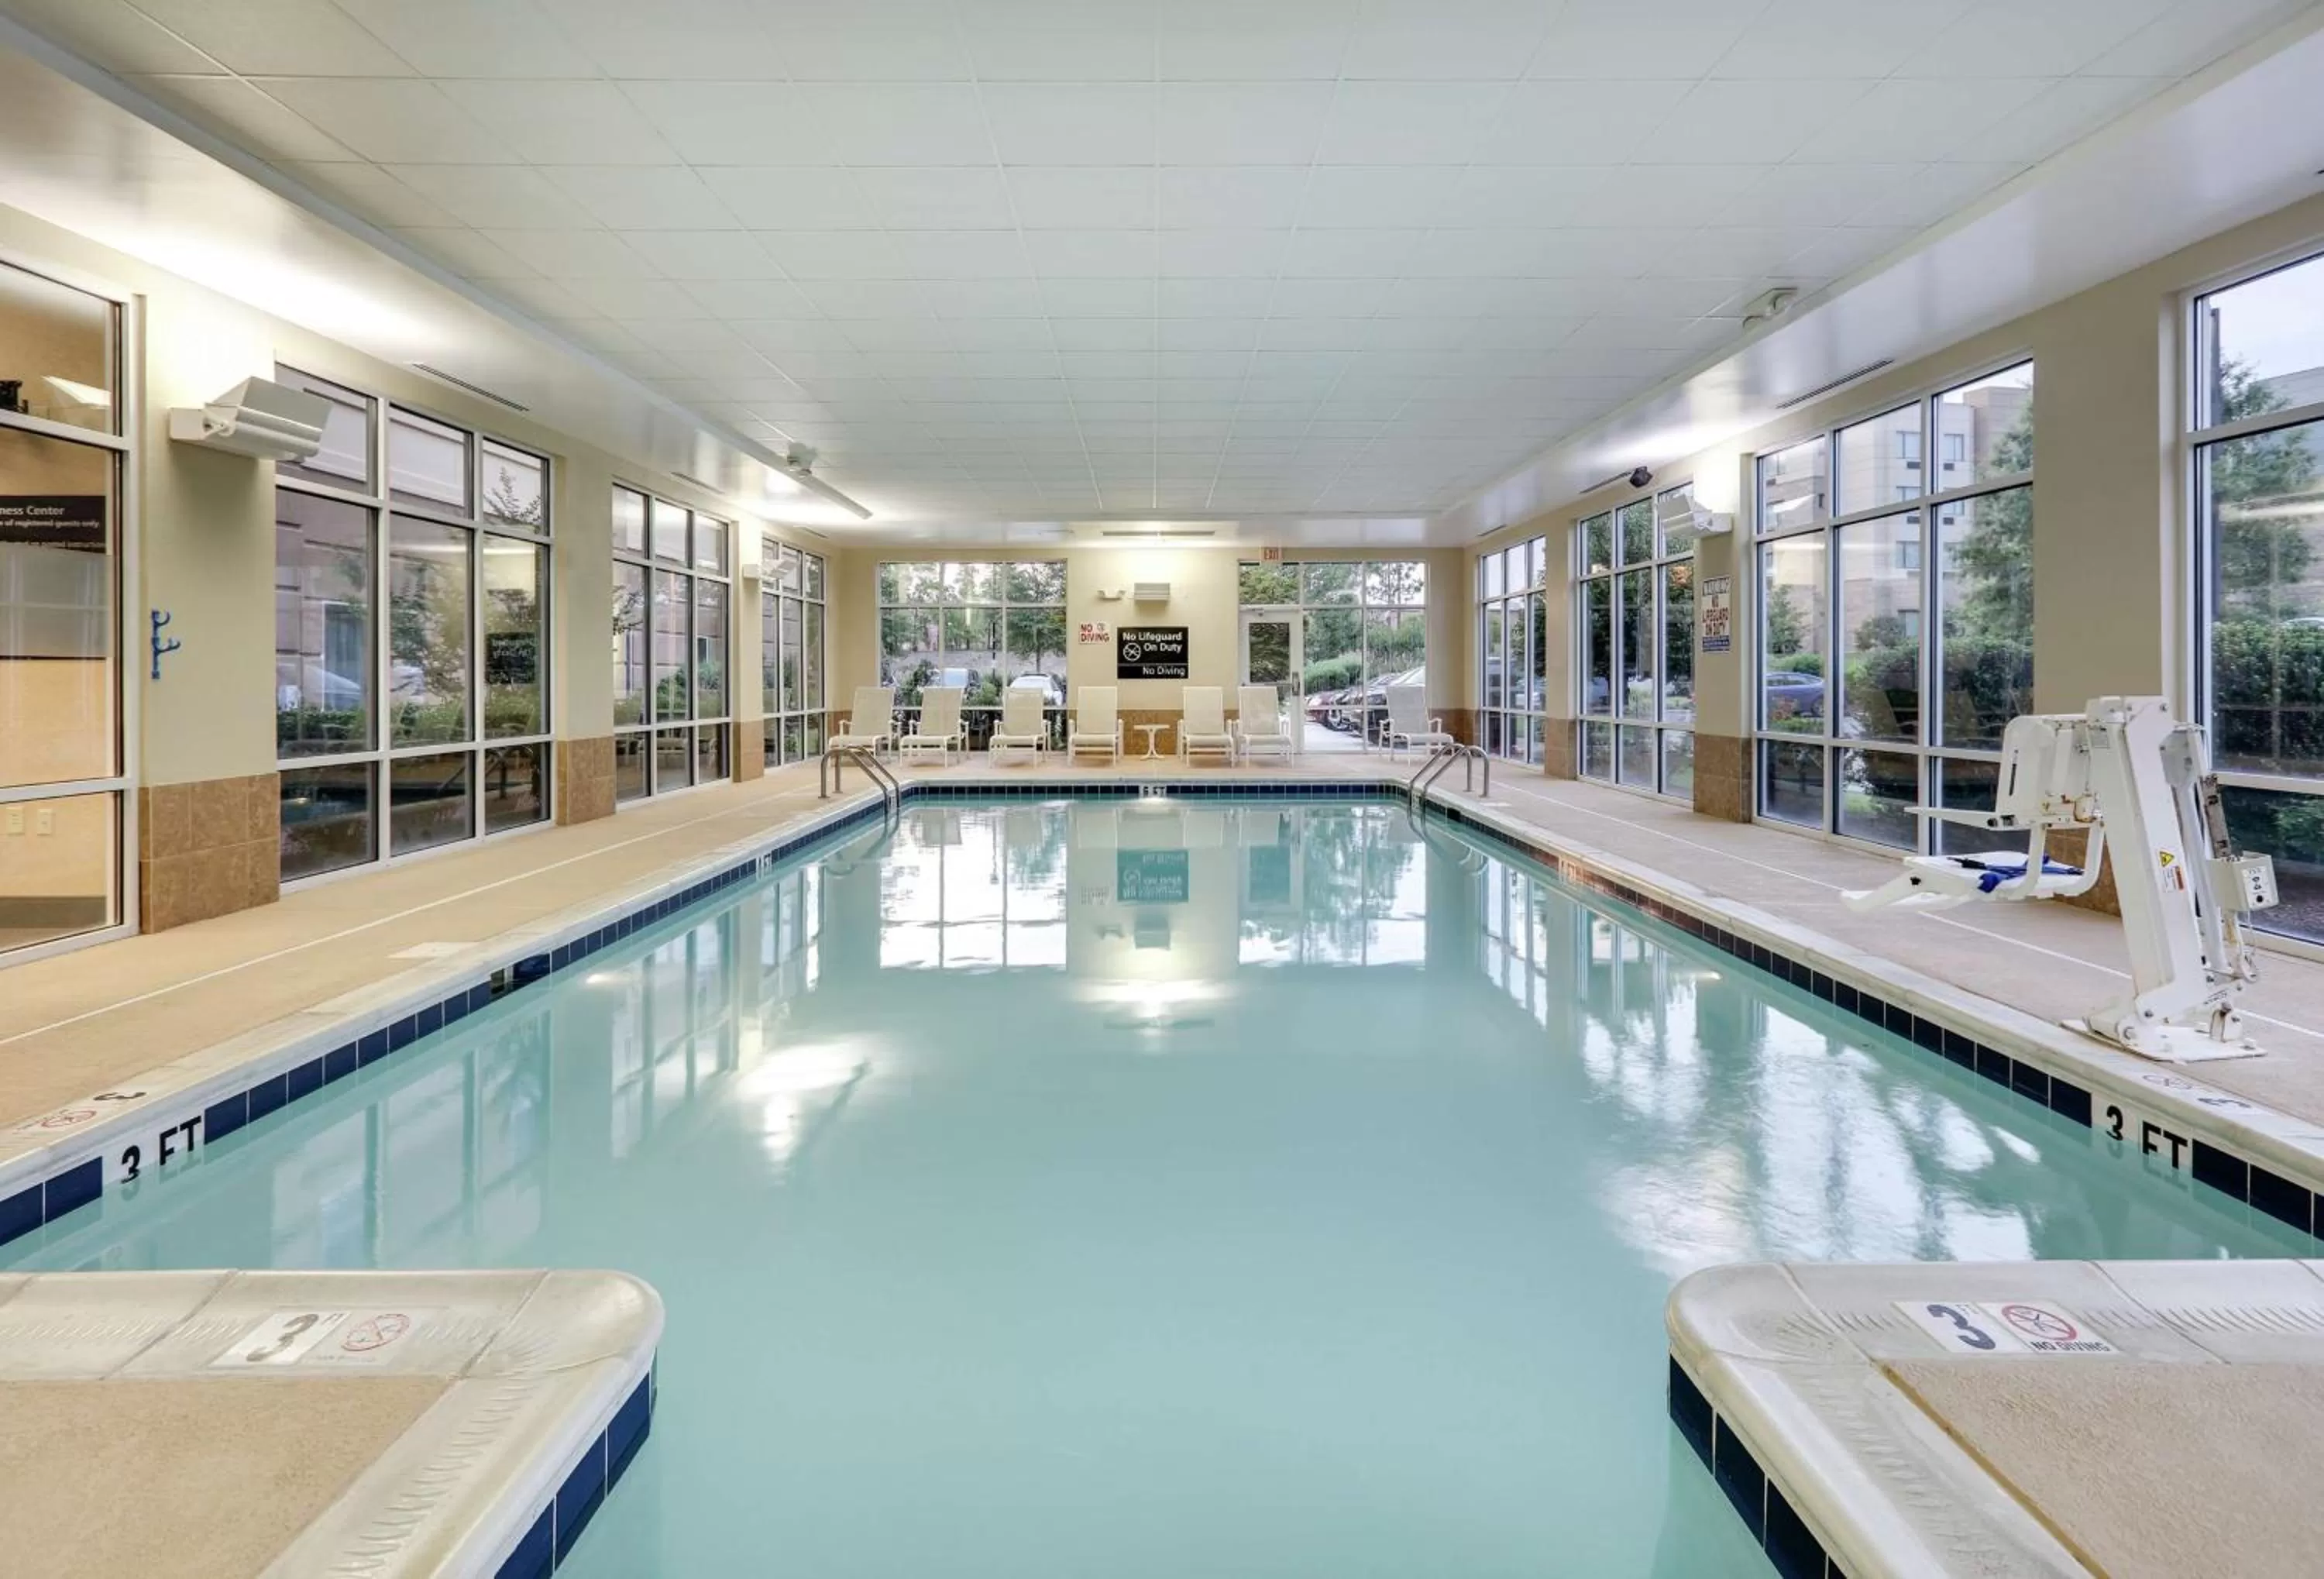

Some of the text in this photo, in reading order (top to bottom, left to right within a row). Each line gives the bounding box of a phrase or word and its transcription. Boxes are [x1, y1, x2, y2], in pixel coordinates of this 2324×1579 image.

[26, 506, 65, 515] Center
[1081, 624, 1093, 632] NO
[1081, 633, 1109, 642] DIVING
[1122, 631, 1183, 642] No Lifeguard
[1143, 642, 1183, 654] On Duty
[1143, 666, 1186, 676] No Diving
[2106, 1105, 2188, 1170] 3 FT
[120, 1115, 202, 1185] 3 FT
[1927, 1304, 1996, 1350] 3
[246, 1313, 319, 1362] 3
[2030, 1341, 2112, 1352] NO DIVING
